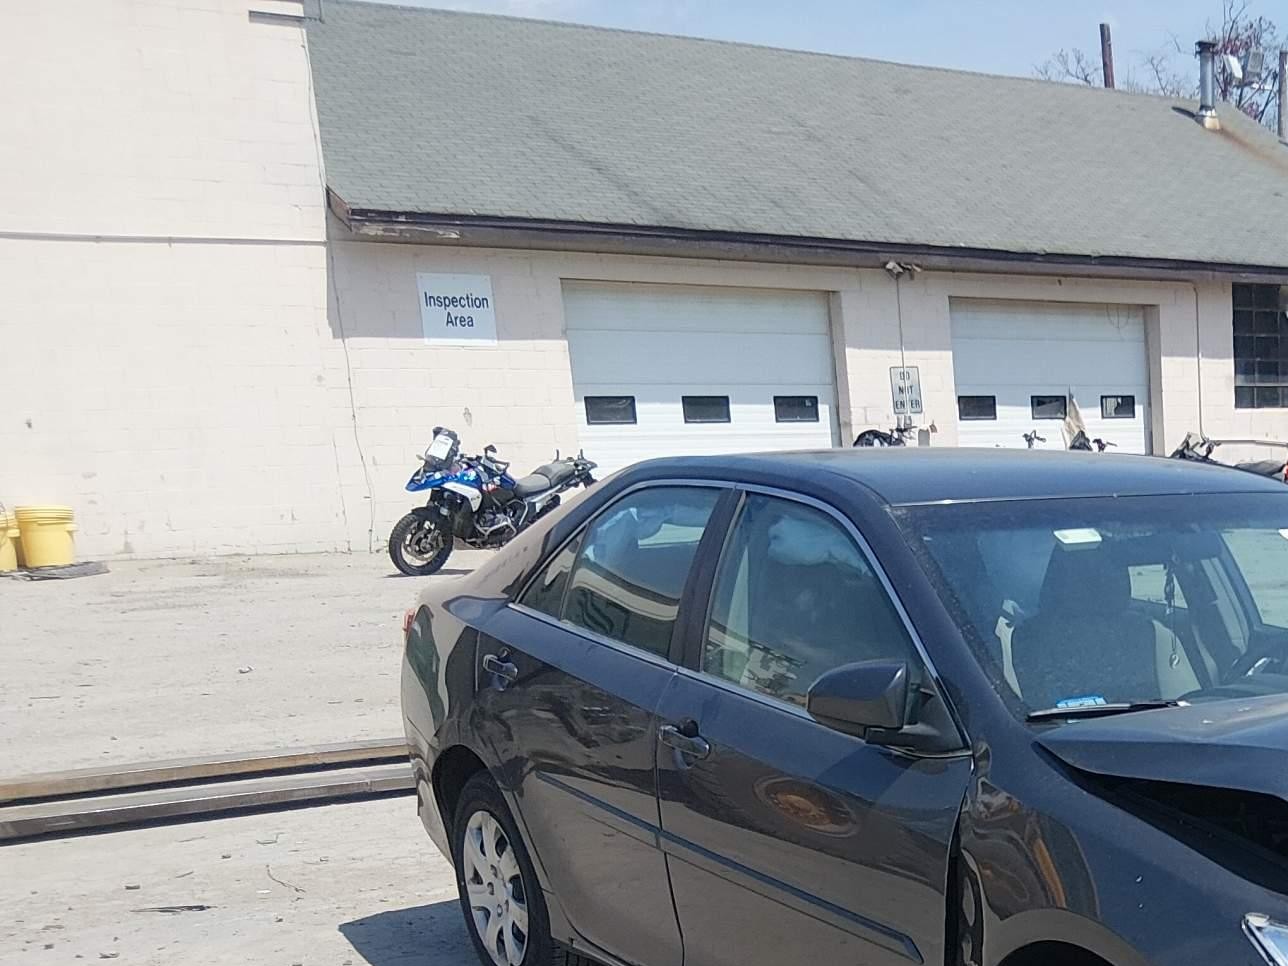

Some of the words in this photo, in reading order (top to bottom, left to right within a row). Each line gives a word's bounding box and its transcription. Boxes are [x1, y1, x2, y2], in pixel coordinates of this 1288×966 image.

[424, 291, 489, 310] Inspection
[446, 311, 474, 328] Area
[895, 399, 920, 410] ENER
